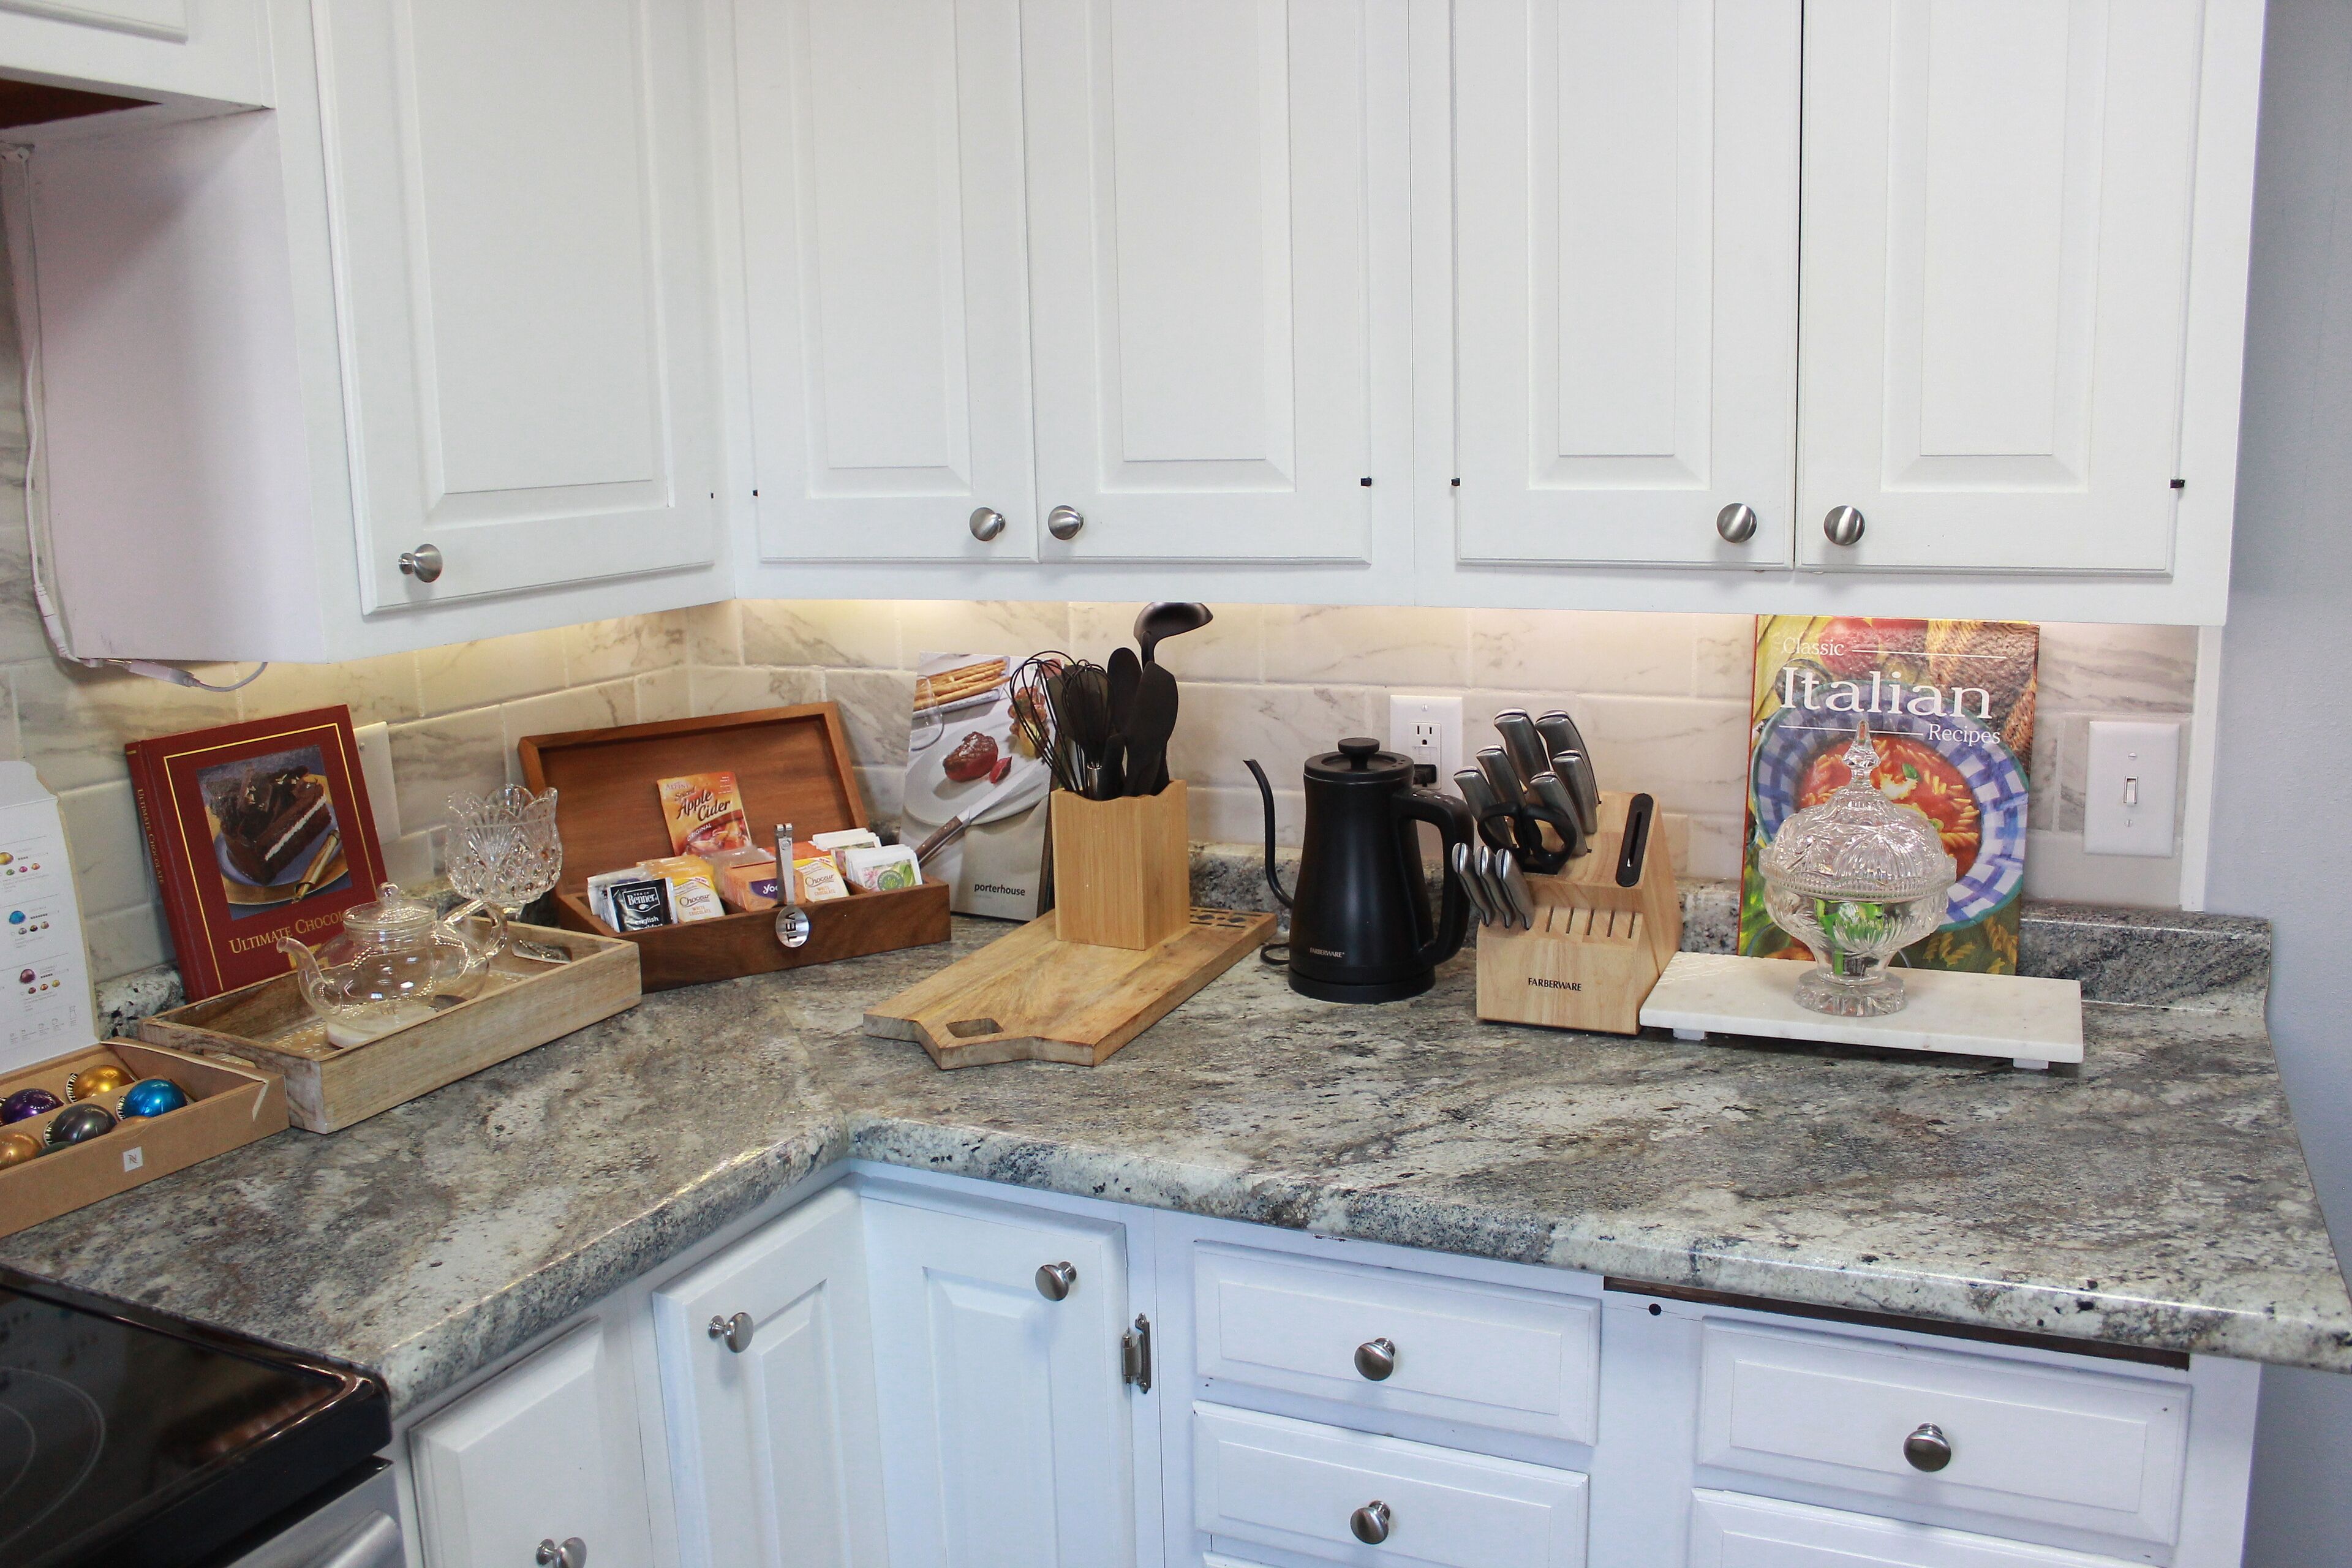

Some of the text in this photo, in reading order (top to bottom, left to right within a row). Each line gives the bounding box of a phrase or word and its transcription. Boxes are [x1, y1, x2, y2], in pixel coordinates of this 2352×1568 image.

[1782, 636, 1845, 656] Classic
[1780, 666, 1992, 720] Italian
[1928, 723, 2001, 747] Recipes
[676, 788, 713, 820] Apple
[698, 799, 732, 822] Cider
[137, 788, 165, 884] ULTIMATE CHOCOLATE
[687, 823, 712, 842] ORIGINAL
[627, 892, 656, 906] Benner
[974, 884, 1026, 896] porterhouse
[228, 910, 345, 954] ULTIMATE CHOCOL
[635, 916, 659, 925] english
[785, 911, 797, 943] TEA
[1528, 978, 1582, 992] FARBERWARE
